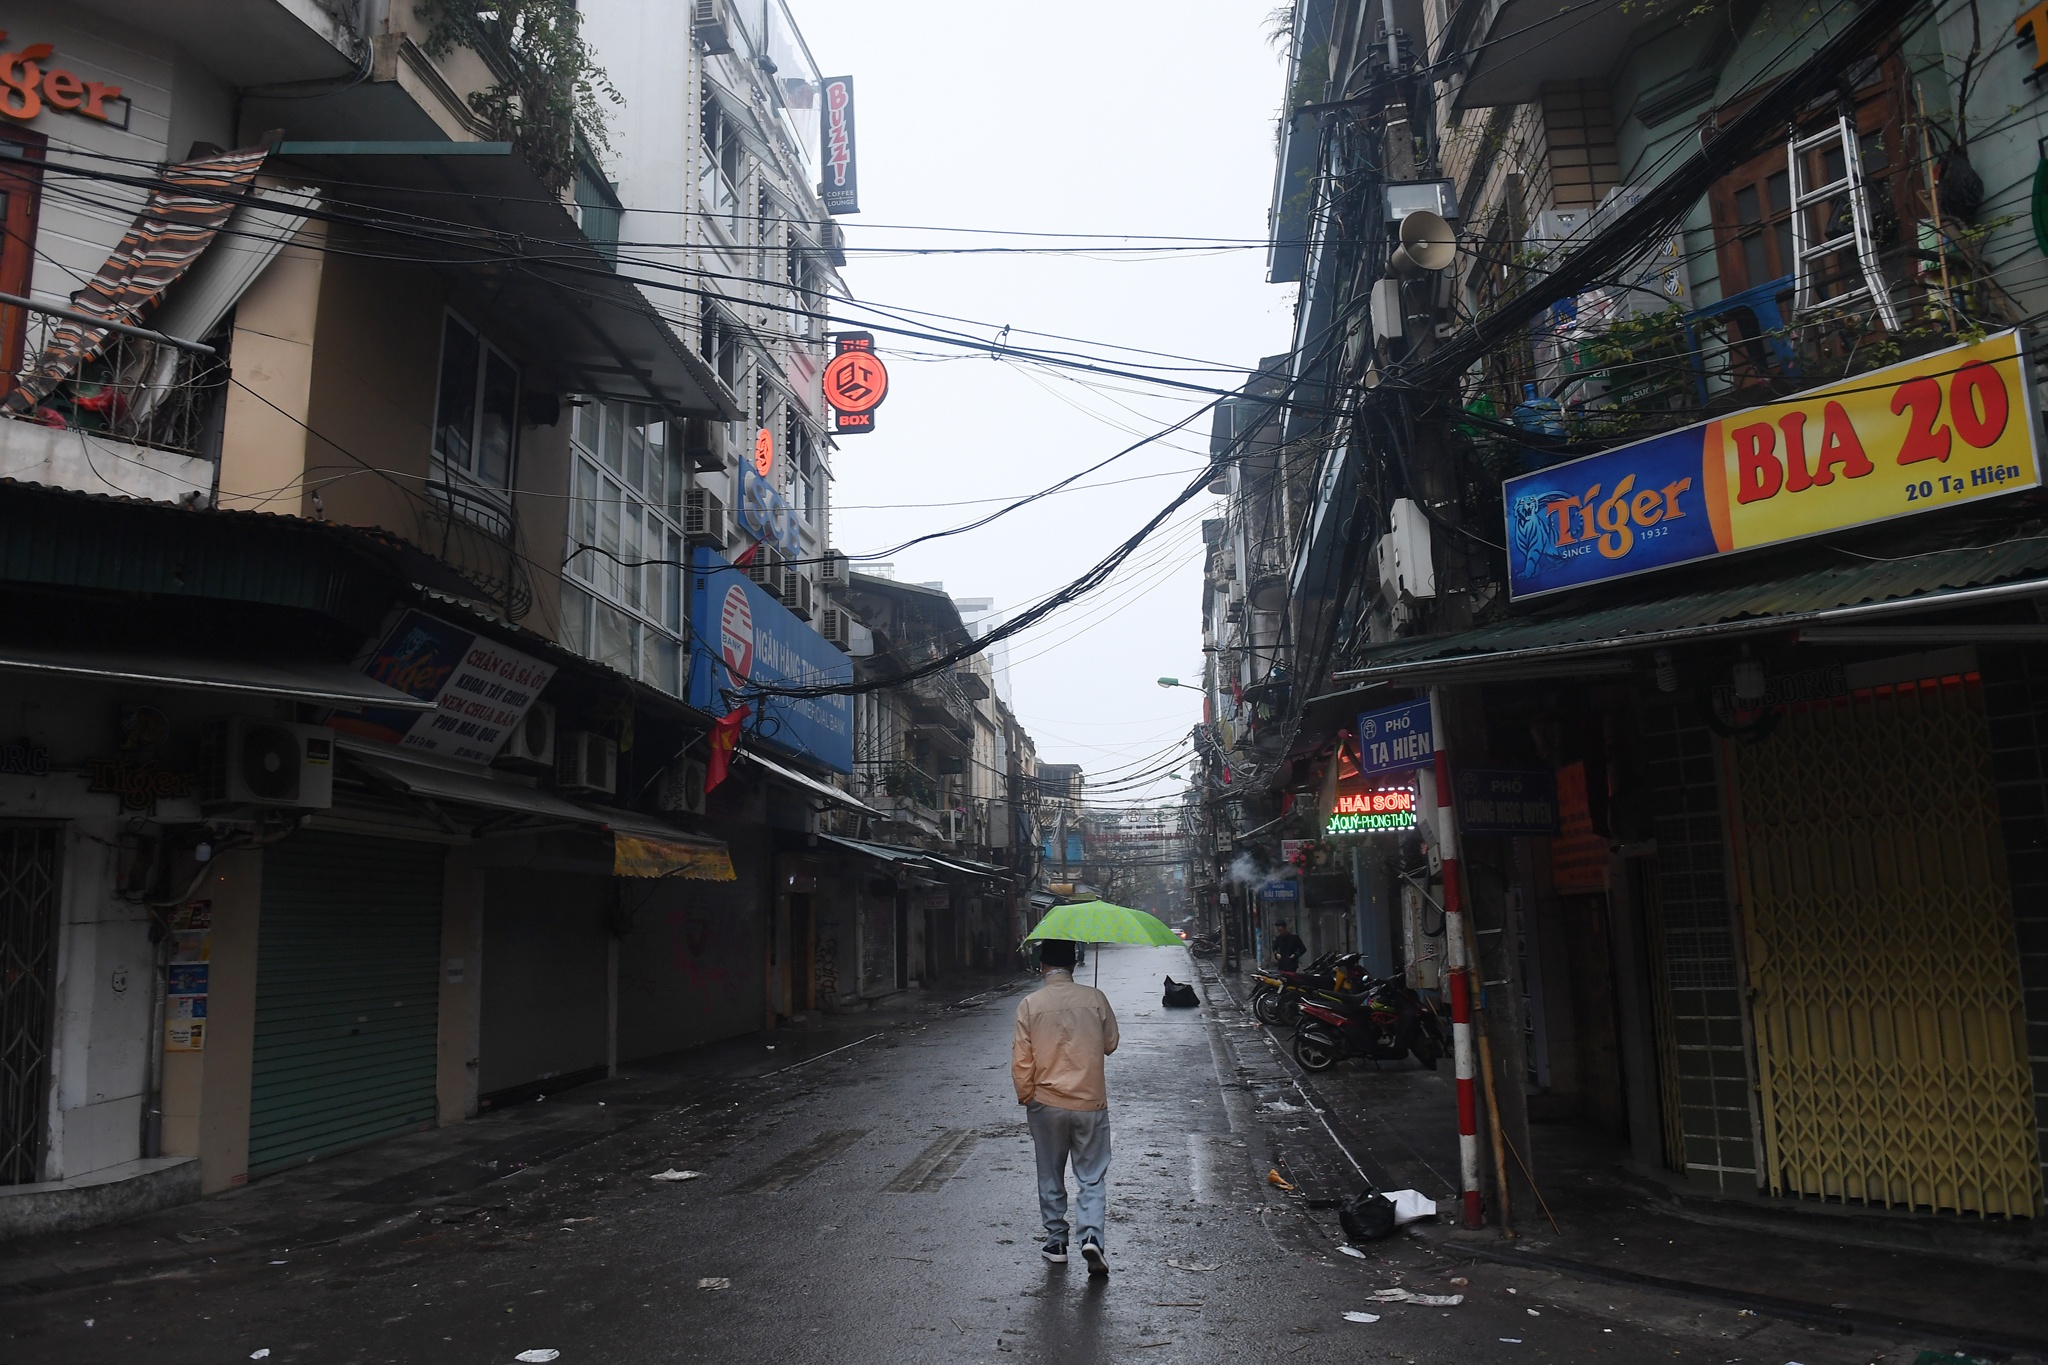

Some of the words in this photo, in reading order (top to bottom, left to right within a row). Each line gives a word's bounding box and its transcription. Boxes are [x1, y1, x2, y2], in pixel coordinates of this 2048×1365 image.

[826, 81, 850, 186] BUZZ!
[826, 190, 854, 198] COFFEE
[827, 199, 855, 207] LOUNGE
[841, 339, 870, 350] THE
[839, 414, 870, 426] BOX
[1731, 400, 1874, 505] BIA
[1890, 359, 2010, 466] 20
[1905, 480, 1933, 502] 20
[1938, 475, 1965, 494] Tạ
[1970, 465, 2020, 486] Hiện
[744, 471, 800, 557] SCB
[1546, 473, 1692, 560] Tiger
[1561, 545, 1592, 559] SINCE
[1640, 526, 1669, 541] 1932
[722, 633, 743, 653] BANK
[755, 627, 779, 671] NGÂN
[779, 641, 801, 685] HÀNG
[373, 652, 451, 694] Tiger
[466, 649, 501, 673] CHÂN
[455, 673, 487, 695] KHOAI
[1711, 662, 1848, 718] TBORG
[439, 693, 466, 714] NEM
[464, 702, 495, 722] CHUA
[494, 709, 520, 728] RÁN
[1385, 711, 1410, 732] PHỐ
[456, 721, 479, 739] MAI
[478, 727, 501, 743] QUE
[1370, 741, 1389, 767] TẠ
[1392, 730, 1430, 761] HIỆN
[87, 755, 194, 811] Tiger
[1491, 775, 1523, 793] PHỐ
[1373, 792, 1411, 811] SƠN
